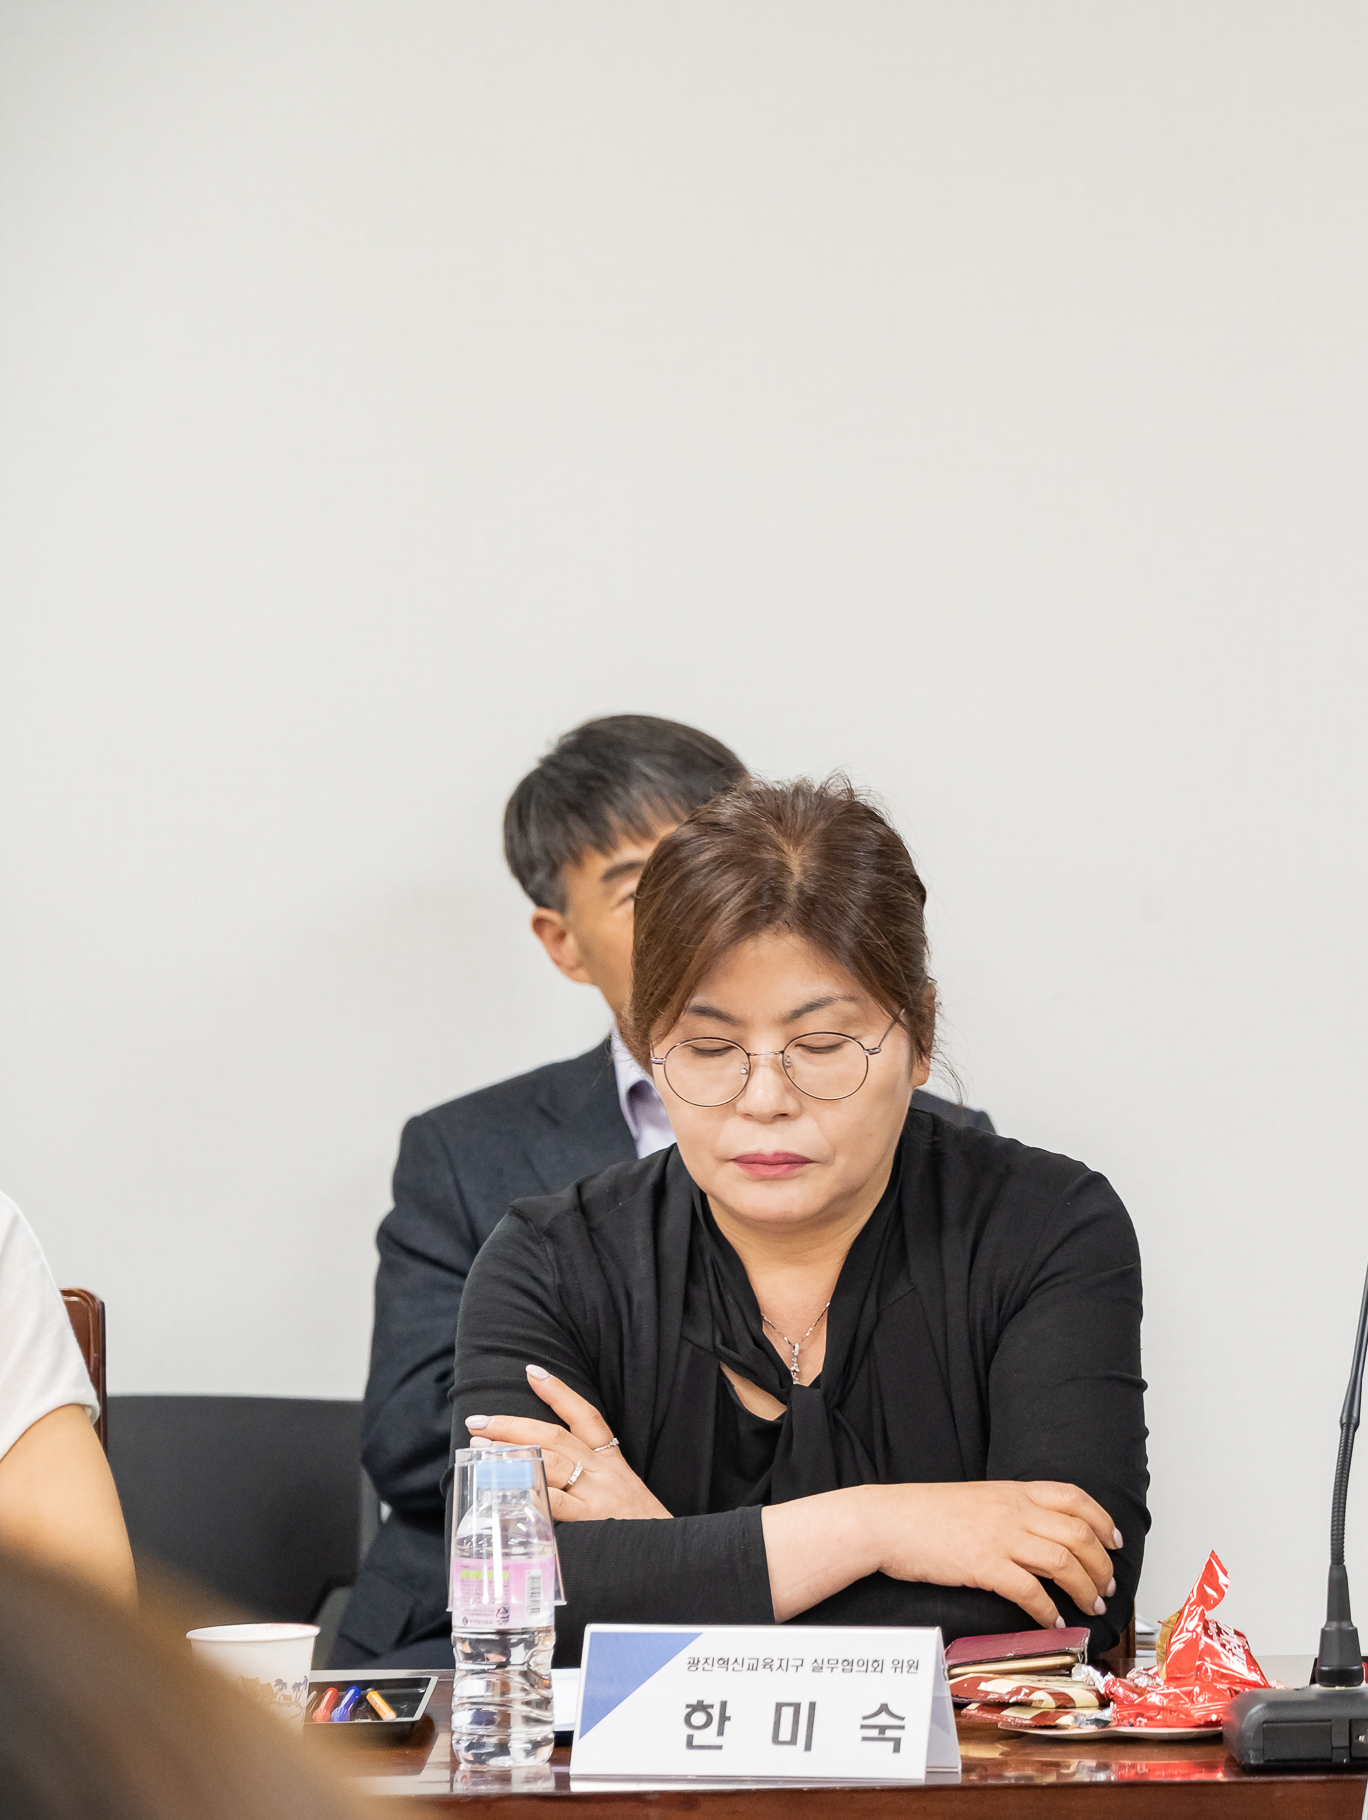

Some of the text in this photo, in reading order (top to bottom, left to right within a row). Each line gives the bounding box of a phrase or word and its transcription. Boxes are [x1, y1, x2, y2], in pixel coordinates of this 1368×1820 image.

[688, 1657, 919, 1673] 광진혁신교육지구 실무협의회 위원
[684, 1700, 905, 1753] 한 미 숙
